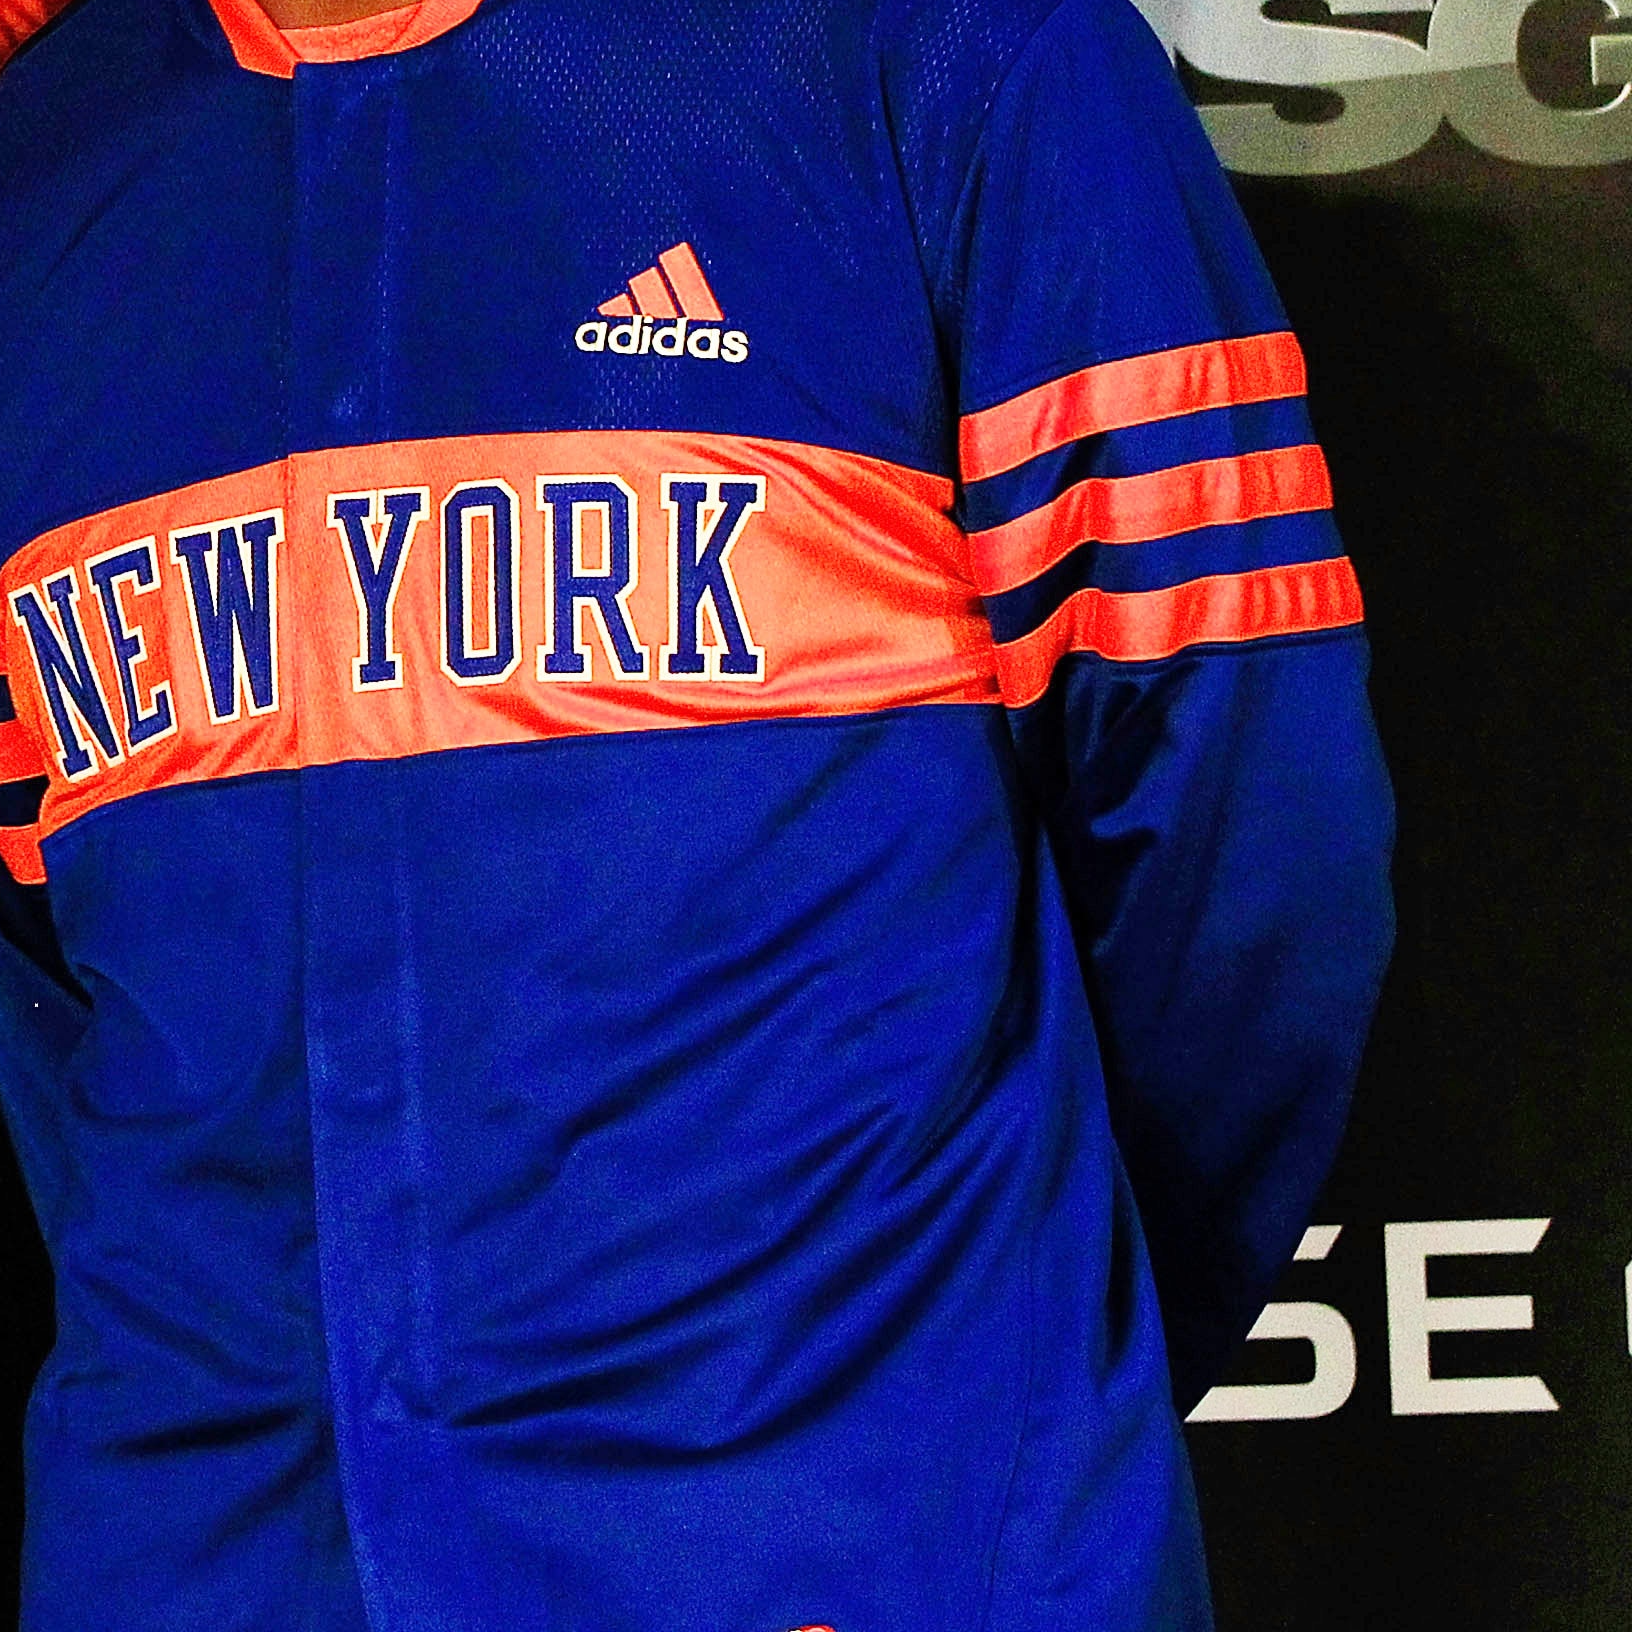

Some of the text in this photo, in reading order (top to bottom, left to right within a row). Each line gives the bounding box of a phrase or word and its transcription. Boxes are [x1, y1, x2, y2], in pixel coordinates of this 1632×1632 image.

[574, 314, 749, 363] adidas
[8, 473, 766, 784] NEW YORK
[1184, 1217, 1561, 1423] SE
